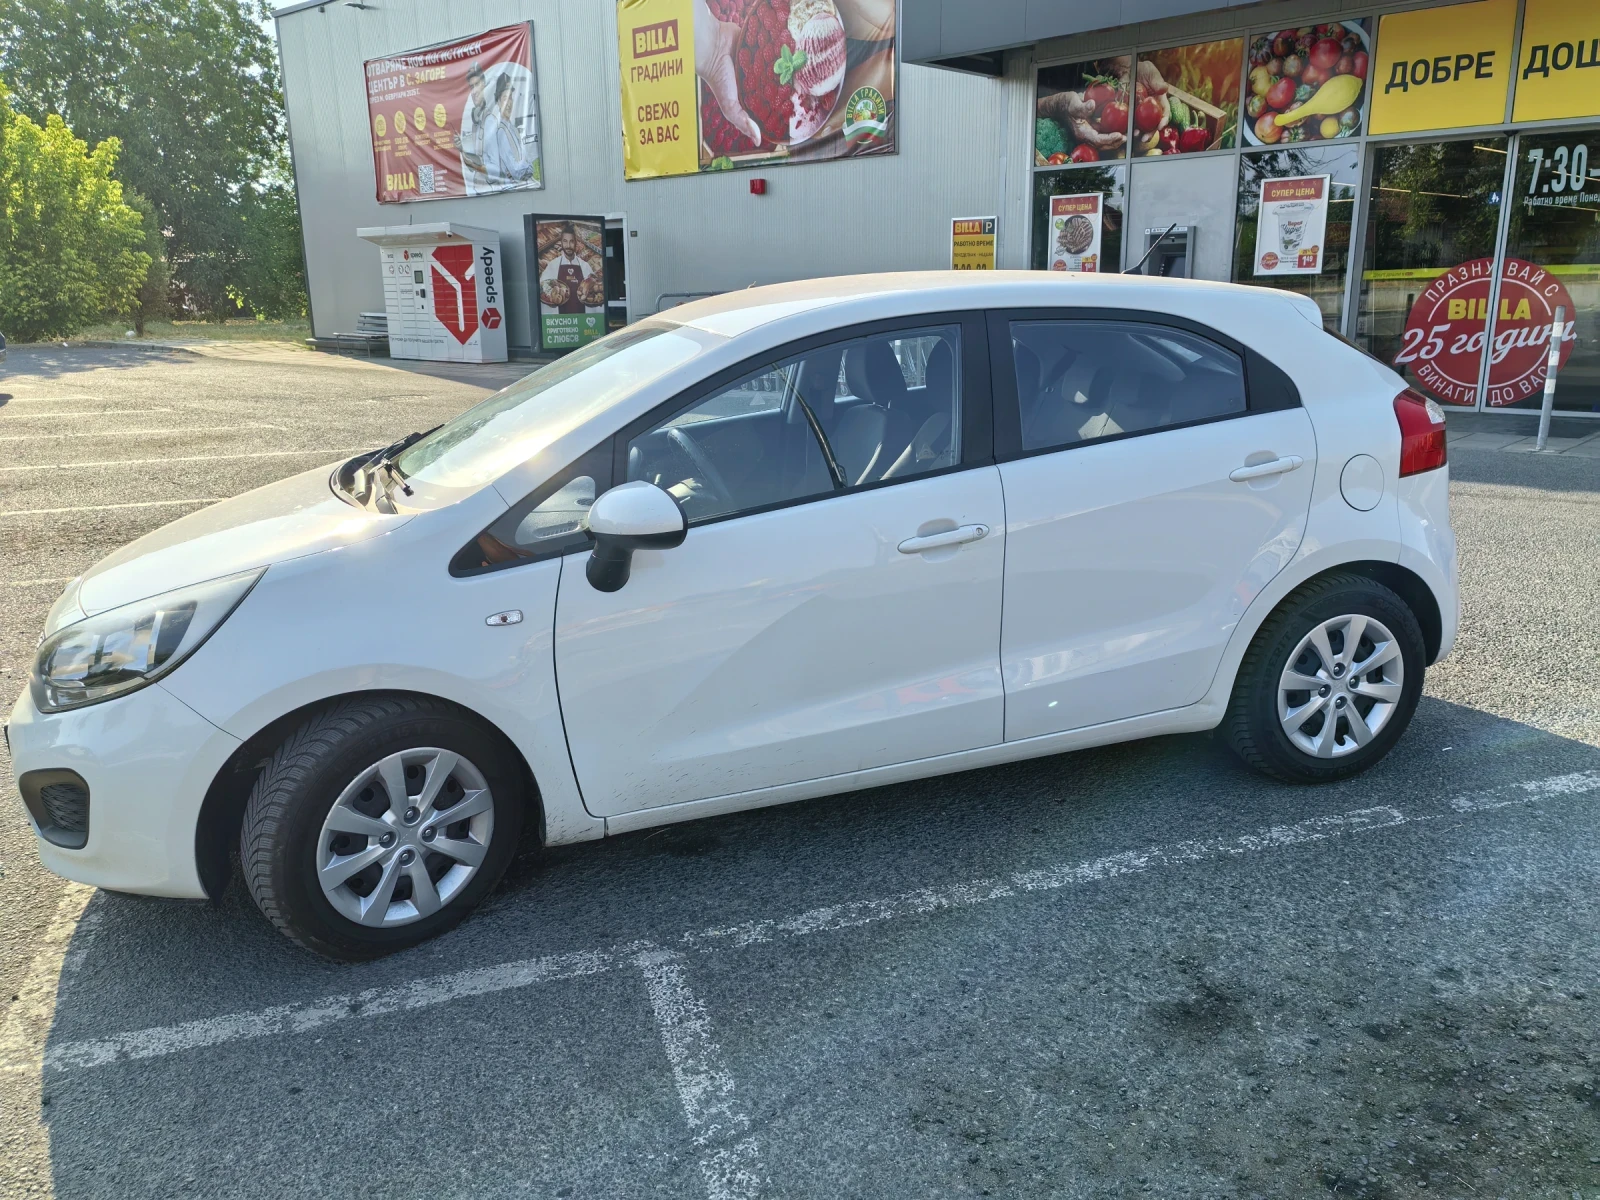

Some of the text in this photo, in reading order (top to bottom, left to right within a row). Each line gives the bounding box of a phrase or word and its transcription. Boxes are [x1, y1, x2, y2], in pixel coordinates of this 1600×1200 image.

[634, 25, 676, 54] BILLA
[368, 78, 398, 95] ЦЕНТЪР
[399, 75, 405, 87] В
[415, 66, 446, 84] ЗАГОРЕ
[631, 58, 683, 83] ГРАДИНИ
[1384, 50, 1496, 94] ДОБРЕ
[637, 100, 680, 123] СВЕЖО
[846, 94, 860, 118] BILLA
[639, 124, 680, 145] ЗА ВАС
[386, 172, 416, 191] BILLA
[1271, 187, 1315, 198] СУПЕР ЦЕНА
[1057, 203, 1093, 212] СУПЕР ЦЕНА
[1524, 195, 1553, 206] Работно
[1555, 195, 1578, 206] време
[955, 221, 980, 233] BILLA
[480, 246, 498, 304] speedy
[1544, 283, 1559, 297] С
[1447, 298, 1531, 320] BILLA
[546, 317, 578, 326] ВКУСНО И
[547, 335, 579, 343] С ЛЮБОВ
[1394, 323, 1451, 364] 25
[1418, 365, 1547, 407] ВИНАГИ ДО ВАС
